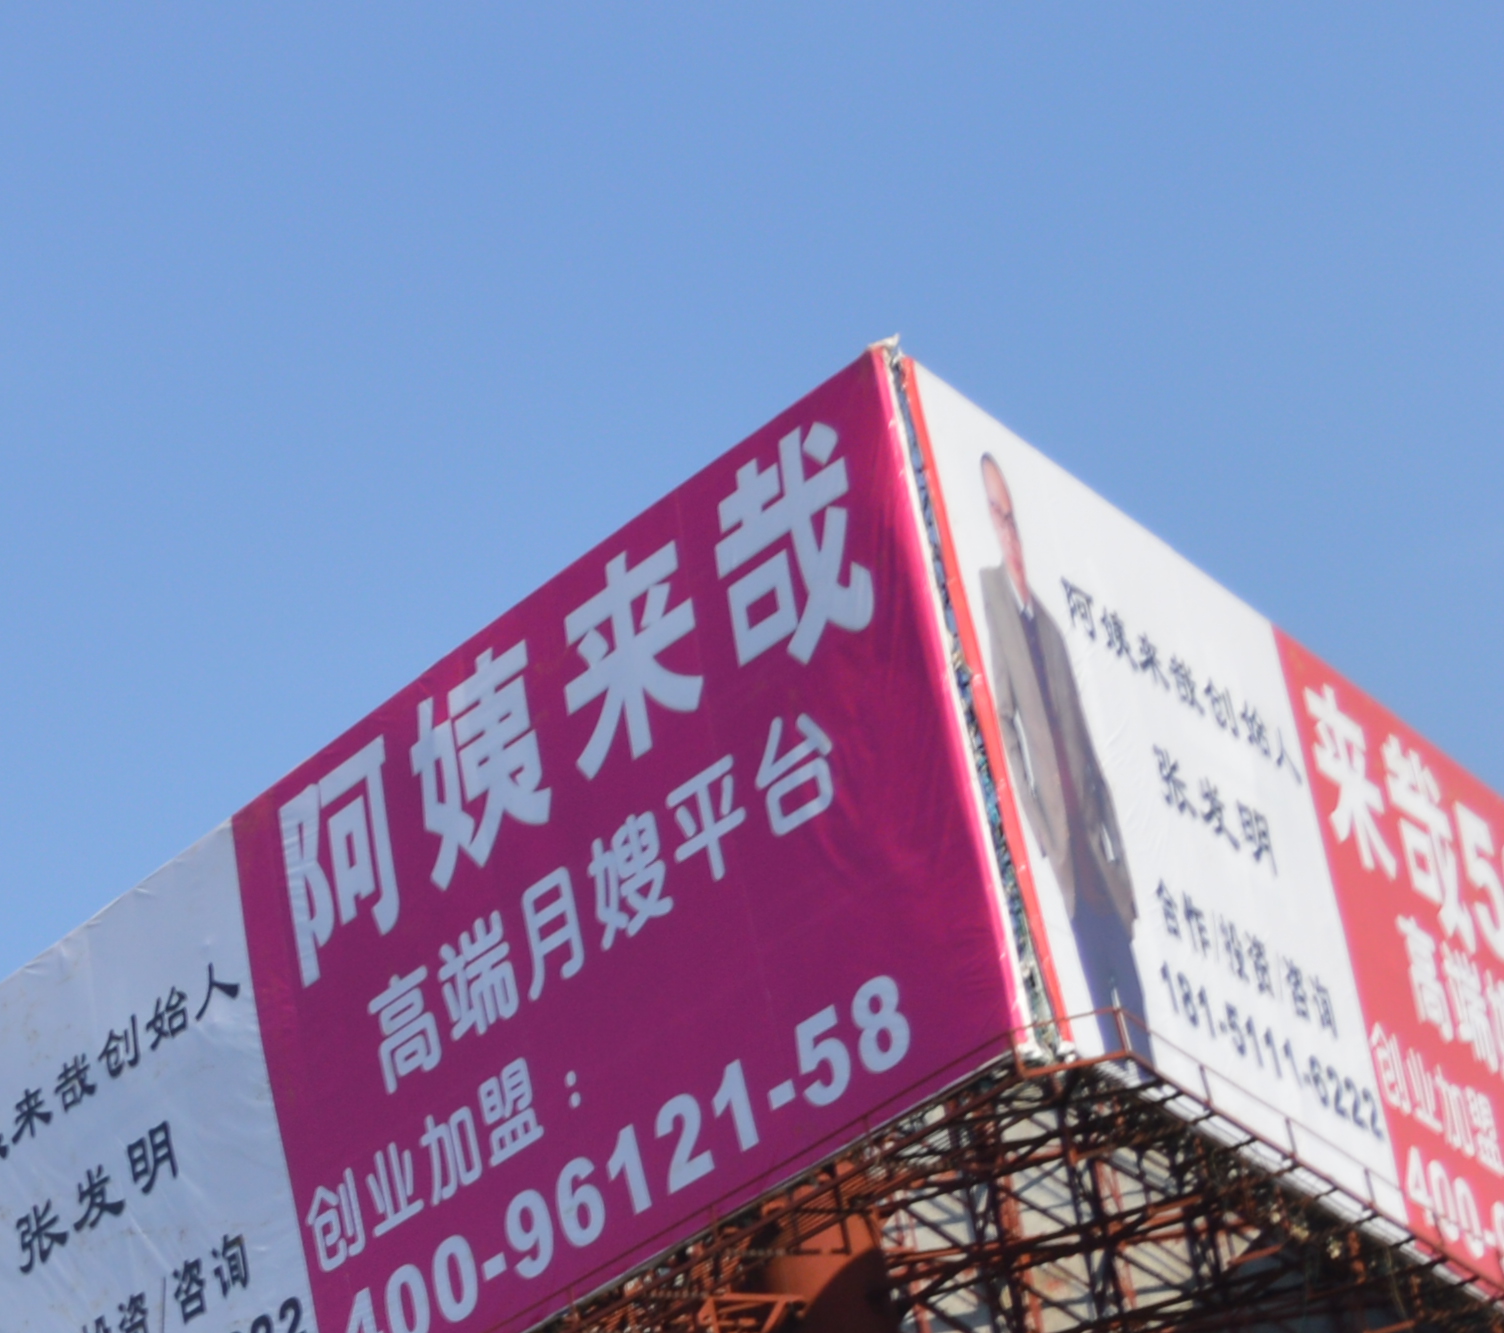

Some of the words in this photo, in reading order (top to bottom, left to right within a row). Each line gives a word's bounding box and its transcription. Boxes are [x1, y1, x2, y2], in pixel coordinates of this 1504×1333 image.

[278, 420, 875, 988] 阿姨来哉
[1302, 680, 1504, 966] 来哉5
[367, 712, 834, 1095] 高端月嫂平台
[16, 1121, 179, 1274] 张发明
